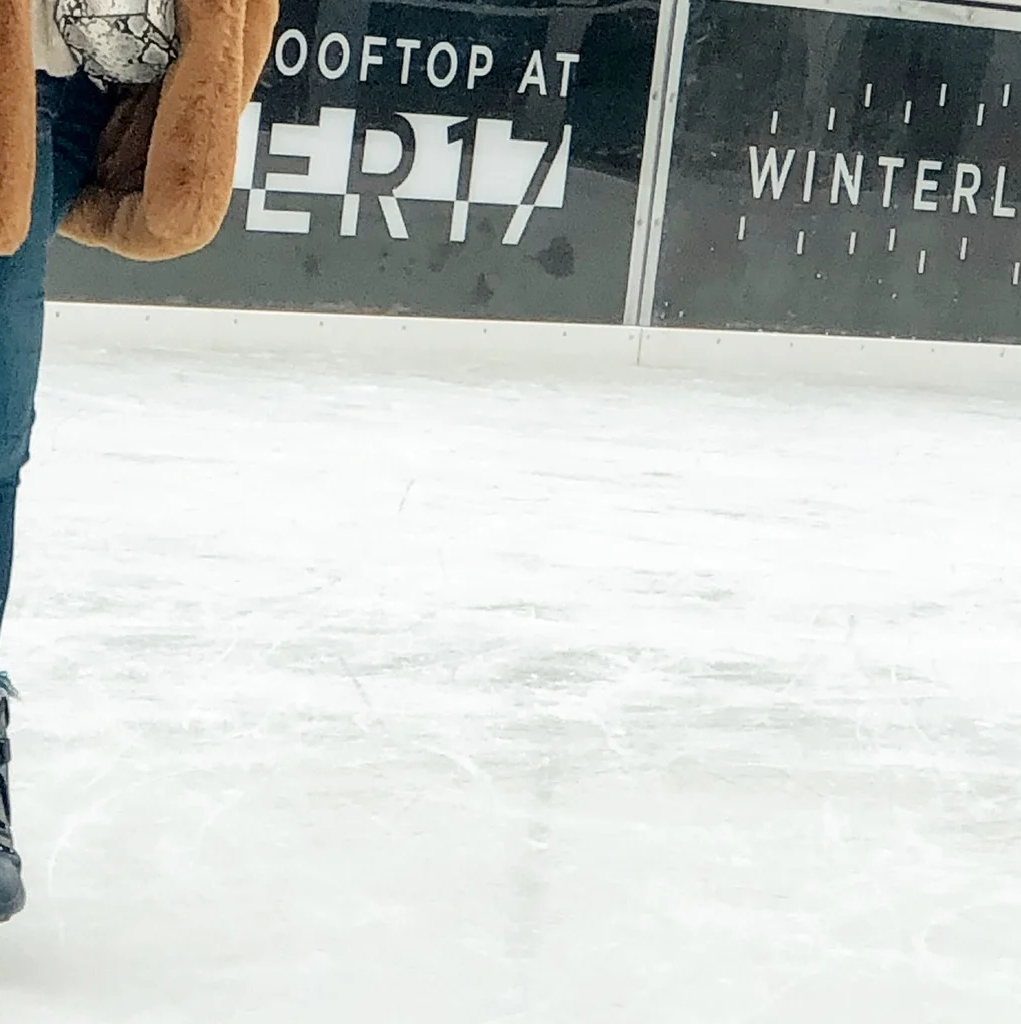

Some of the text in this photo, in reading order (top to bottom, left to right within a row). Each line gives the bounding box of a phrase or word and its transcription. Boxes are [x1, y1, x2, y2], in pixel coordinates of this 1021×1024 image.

[275, 28, 580, 97] OOFTOP AT
[240, 103, 571, 245] ER17
[748, 145, 1016, 218] WINTERL
